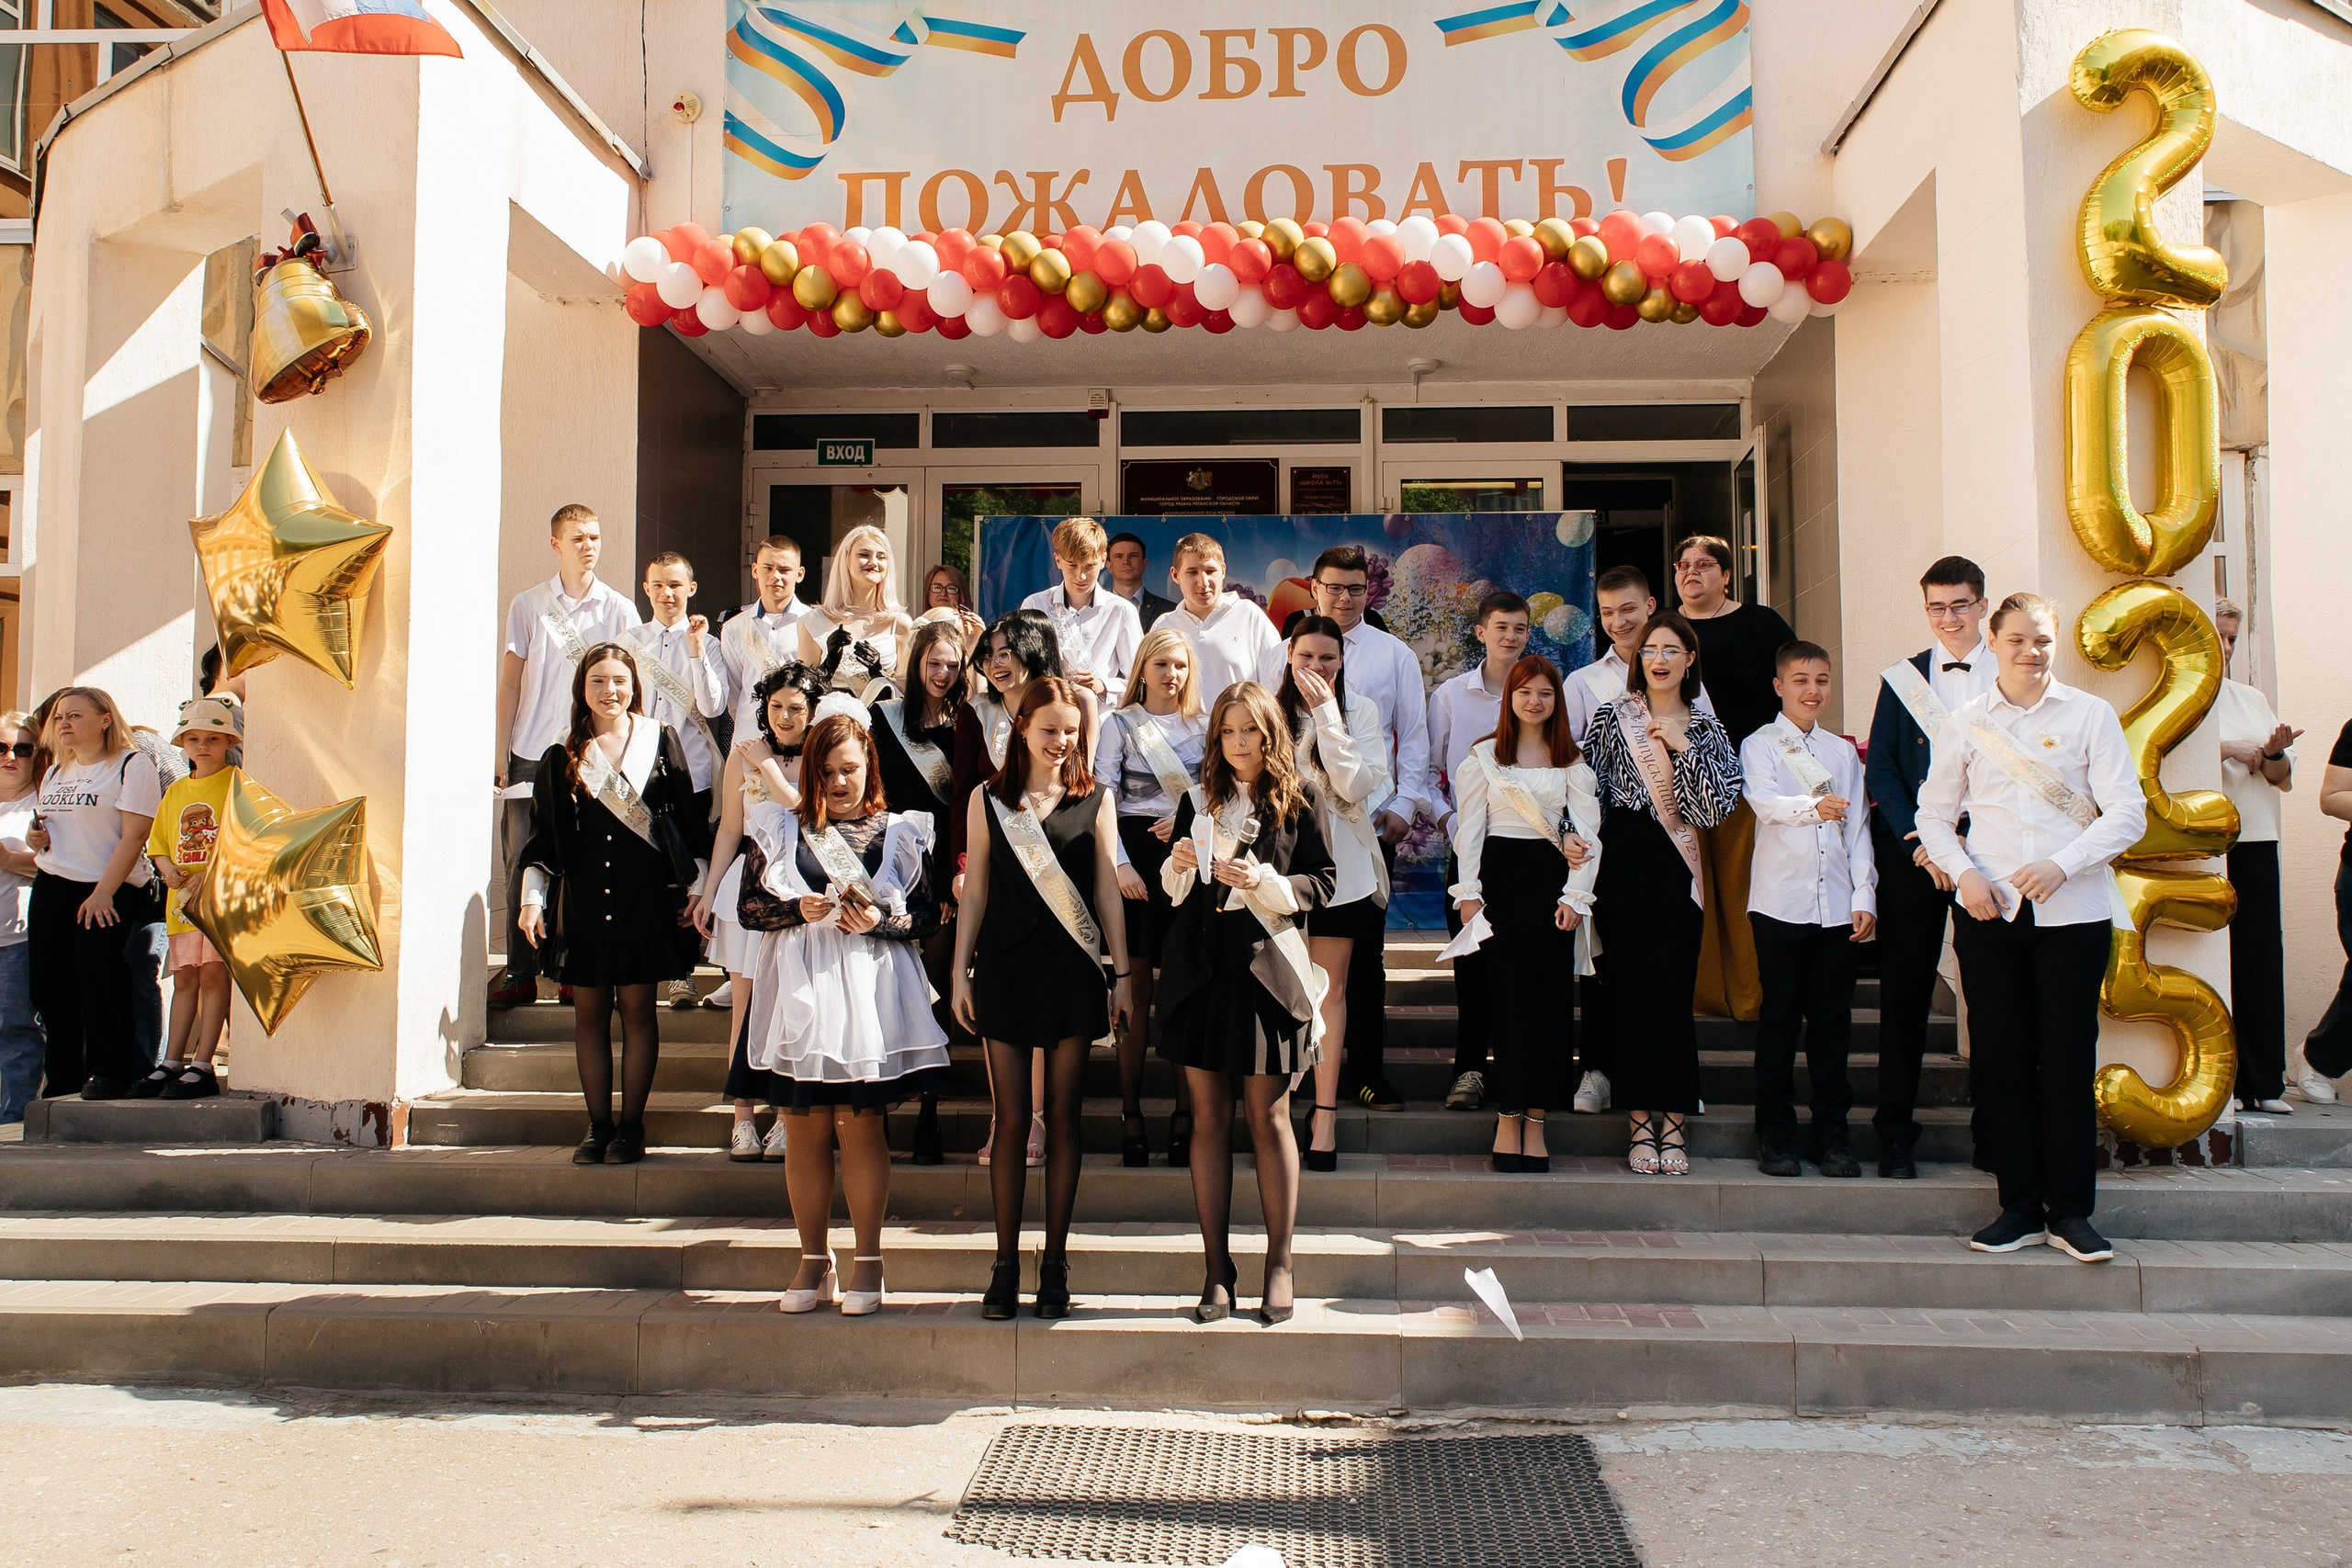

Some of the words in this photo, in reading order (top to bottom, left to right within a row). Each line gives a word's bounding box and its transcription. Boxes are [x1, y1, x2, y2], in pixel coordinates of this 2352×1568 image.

[1050, 23, 1408, 122] ДОБРО
[837, 157, 1628, 238] ПОЖАЛОВАТЬ!
[826, 445, 865, 463] ВХОД
[56, 785, 78, 794] USA
[1630, 722, 1679, 818] Выпускница
[1673, 825, 1700, 863] 2025
[2055, 791, 2099, 830] 2025
[183, 851, 208, 863] CHILI
